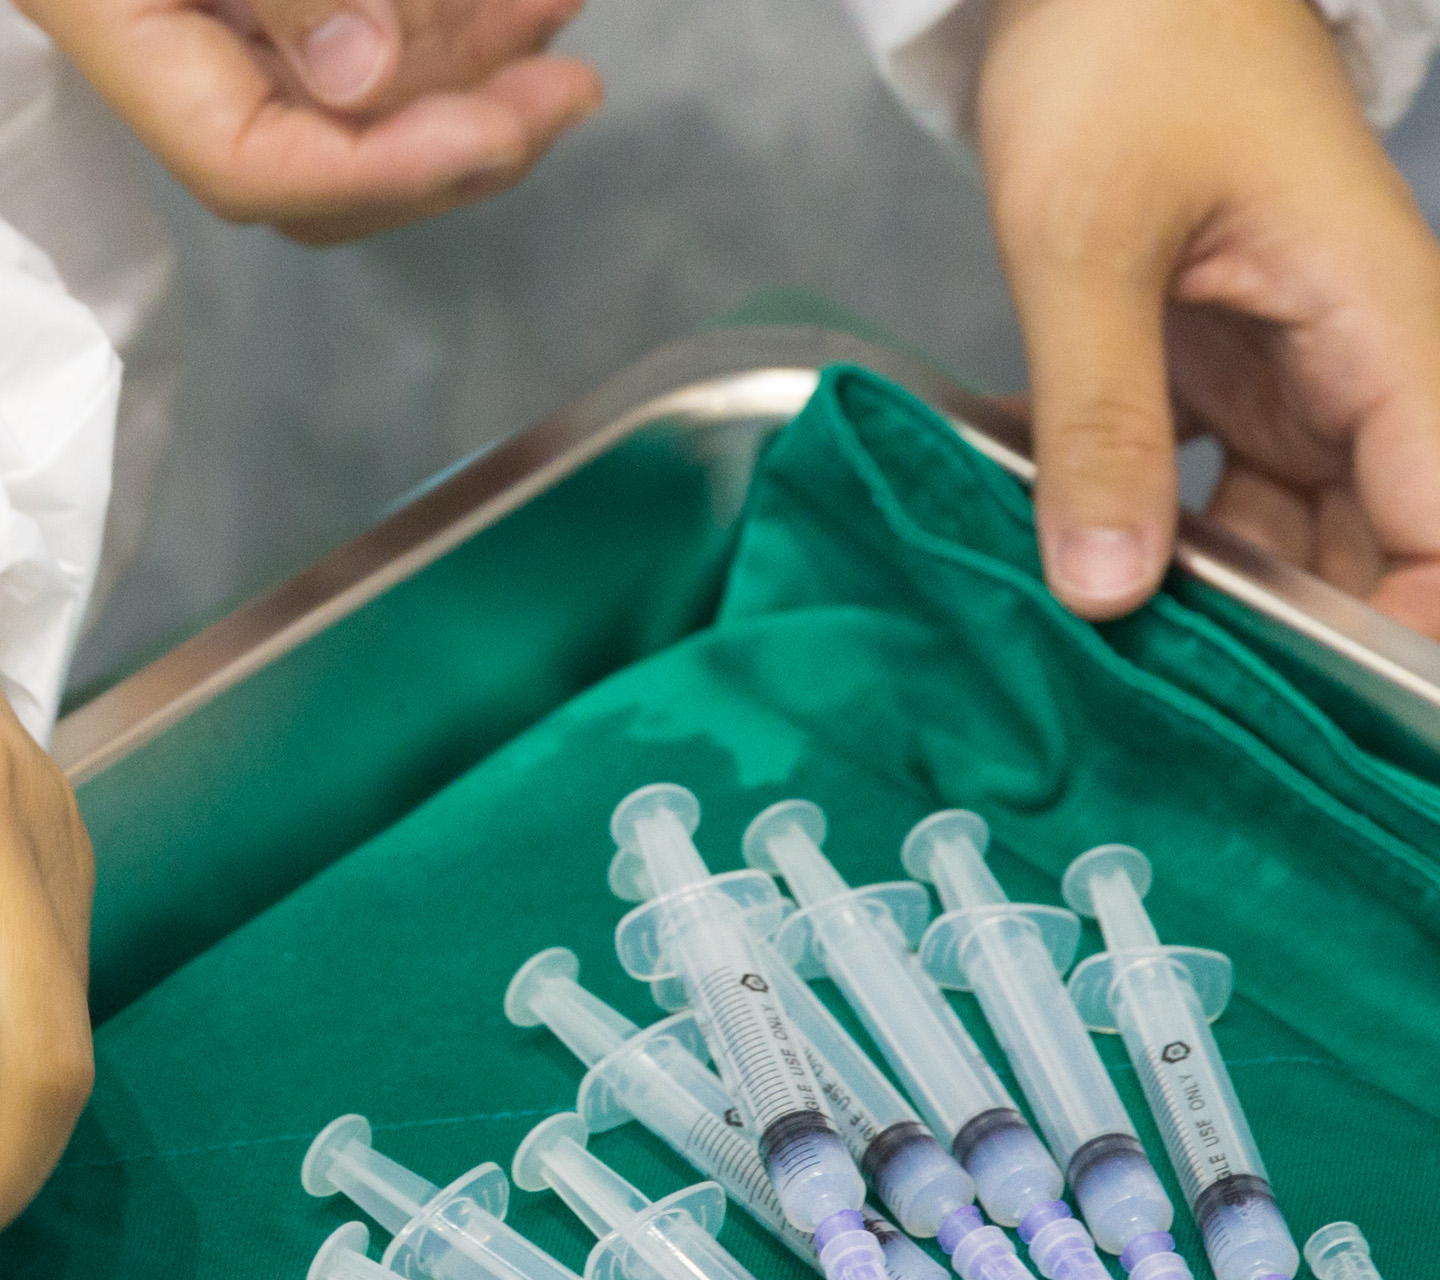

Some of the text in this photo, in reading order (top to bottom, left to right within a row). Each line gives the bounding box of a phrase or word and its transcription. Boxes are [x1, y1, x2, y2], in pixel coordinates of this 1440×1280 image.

[761, 1003, 788, 1041] ONLY
[782, 1048, 805, 1076] USE
[1180, 1074, 1205, 1110] ONLY
[1196, 1120, 1219, 1147] USE
